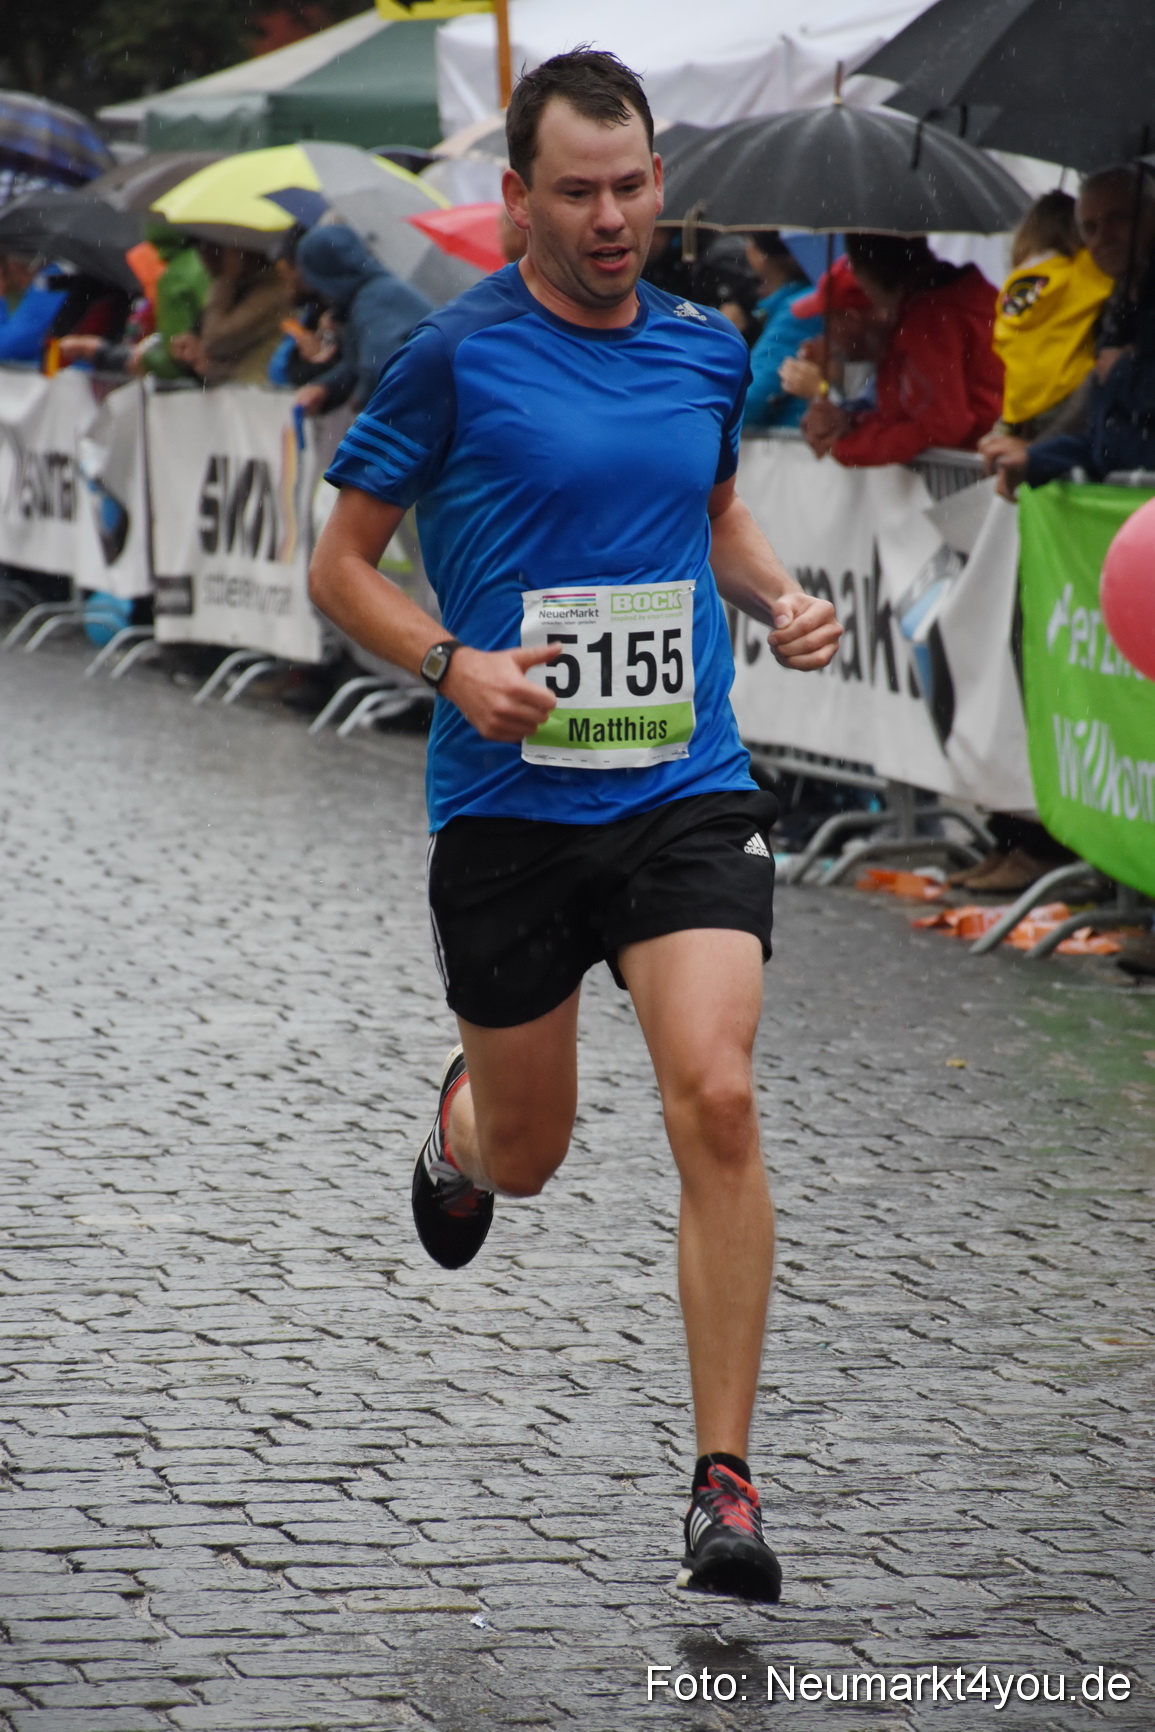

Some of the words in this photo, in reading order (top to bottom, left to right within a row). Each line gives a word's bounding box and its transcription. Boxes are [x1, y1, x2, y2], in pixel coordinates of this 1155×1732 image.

[539, 608, 599, 619] NeuerMarkt
[611, 590, 683, 614] BOCK
[545, 628, 683, 698] 5155
[568, 716, 668, 743] Matthias
